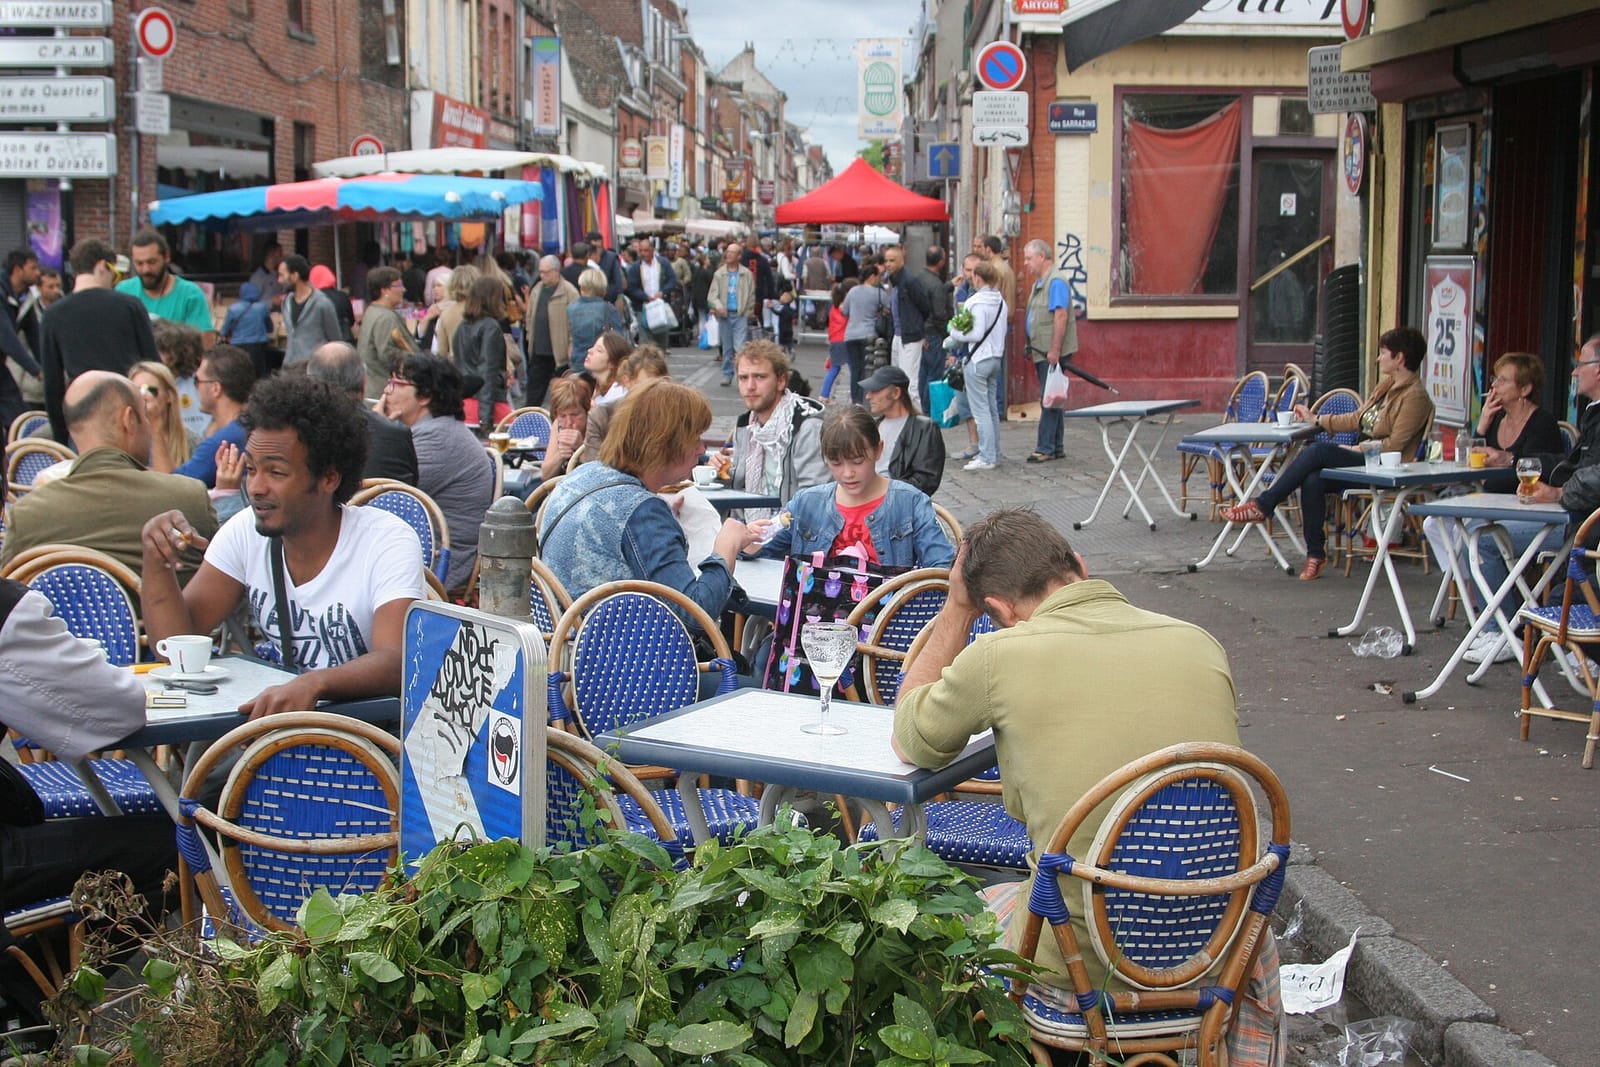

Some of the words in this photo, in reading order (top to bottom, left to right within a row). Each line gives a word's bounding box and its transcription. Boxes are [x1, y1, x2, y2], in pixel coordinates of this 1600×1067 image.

[1021, 0, 1060, 9] ARTOIS
[12, 5, 98, 18] WAZEMMES
[1313, 77, 1322, 85] DE
[20, 85, 36, 97] de
[42, 84, 99, 98] Quartier
[1315, 88, 1330, 96] LES
[1073, 107, 1086, 116] Rue
[1050, 119, 1061, 128] des
[1062, 120, 1096, 129] SARRAZINS
[33, 142, 50, 153] de
[0, 157, 39, 169] bitat
[46, 156, 104, 169] Durable
[1434, 318, 1456, 356] 25
[327, 627, 345, 637] '76
